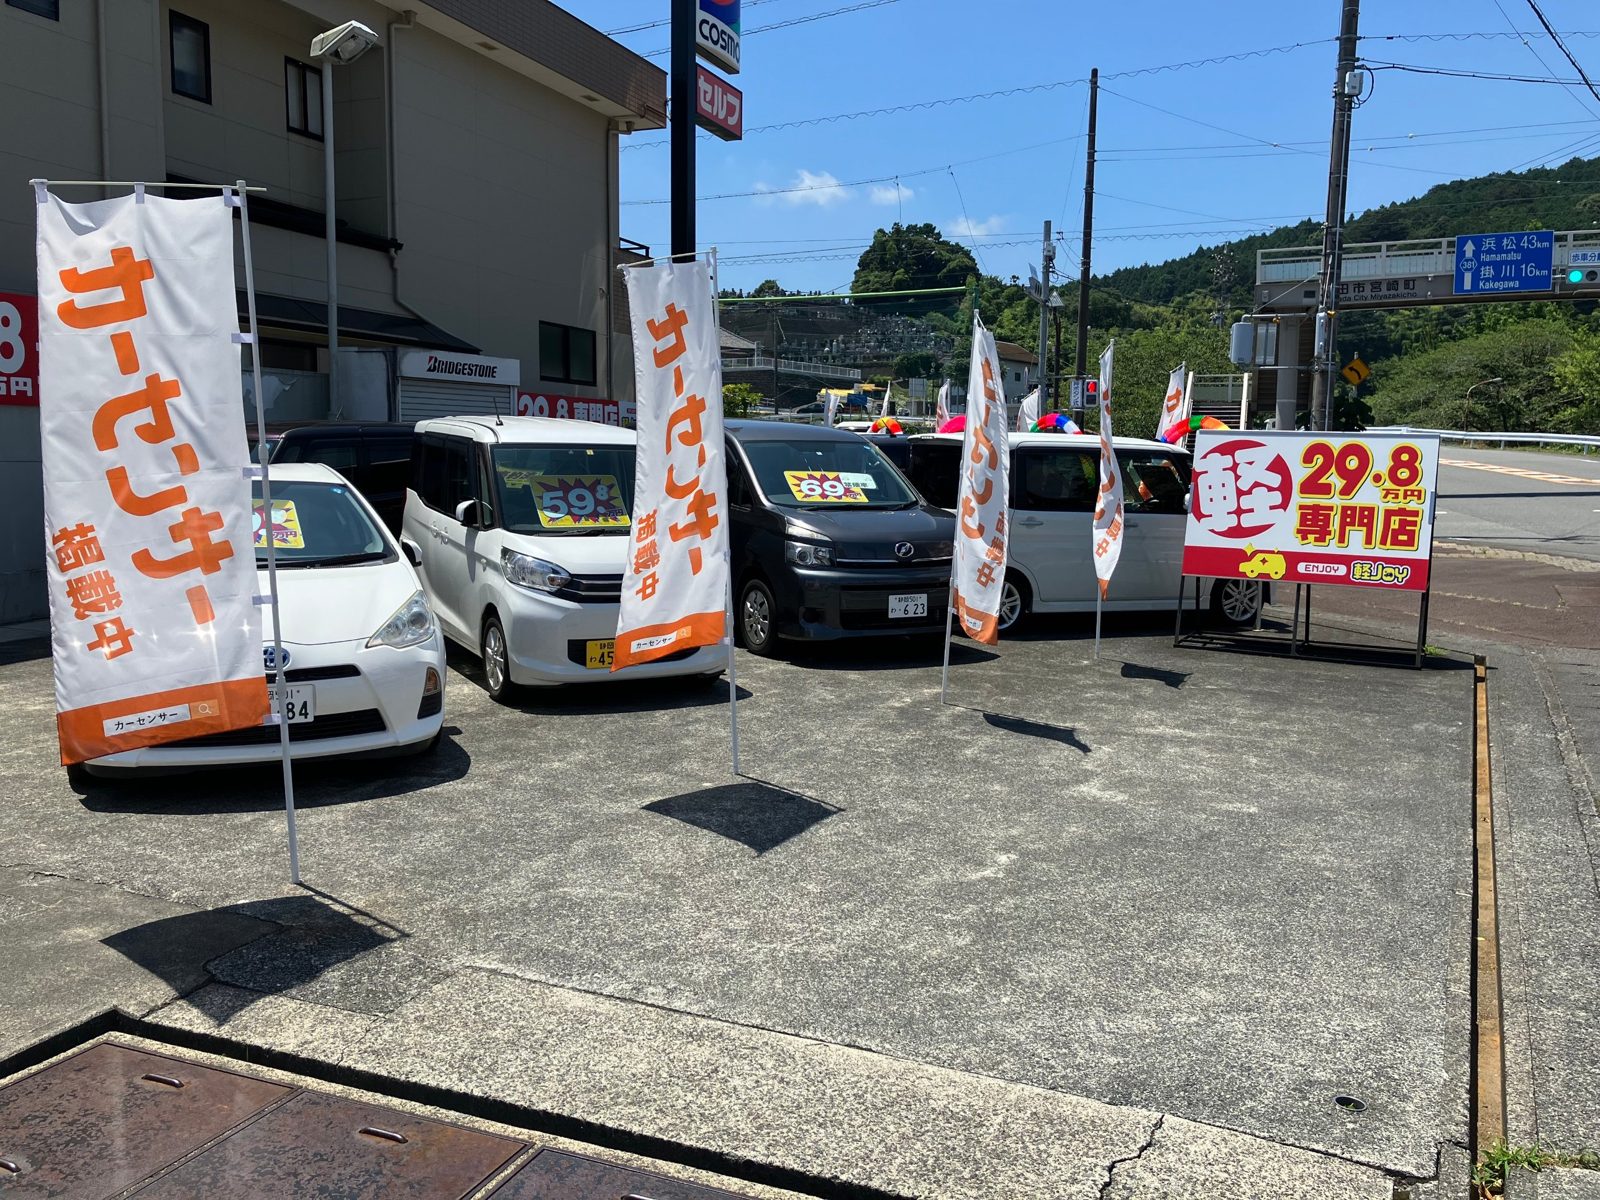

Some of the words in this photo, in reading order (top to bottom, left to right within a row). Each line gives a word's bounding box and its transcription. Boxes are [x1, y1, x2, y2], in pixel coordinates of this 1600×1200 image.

[699, 19, 740, 63] COSMO
[699, 75, 740, 125] セルフ
[1482, 236, 1516, 251] 浜松
[1463, 261, 1476, 269] 381
[1480, 251, 1521, 262] Hamamatsu
[1480, 264, 1515, 279] 掛川
[1370, 292, 1417, 300] Miyazakicho
[1479, 280, 1519, 290] Kakegawa
[427, 356, 497, 378] BRIDGESTONE
[57, 246, 235, 626] カーセンサー
[647, 302, 719, 576] カーセンサー
[1299, 441, 1422, 498] 29.8
[1193, 450, 1283, 532] 軽
[1381, 488, 1424, 502] 万円
[1296, 503, 1421, 550] 専門店
[634, 509, 660, 601] 掲載中
[1304, 564, 1339, 574] ENJOY
[1352, 561, 1409, 583] 軽JOY
[52, 523, 134, 660] 掲載中
[635, 637, 672, 649] カーセンサー
[114, 712, 179, 731] カーセンサー
